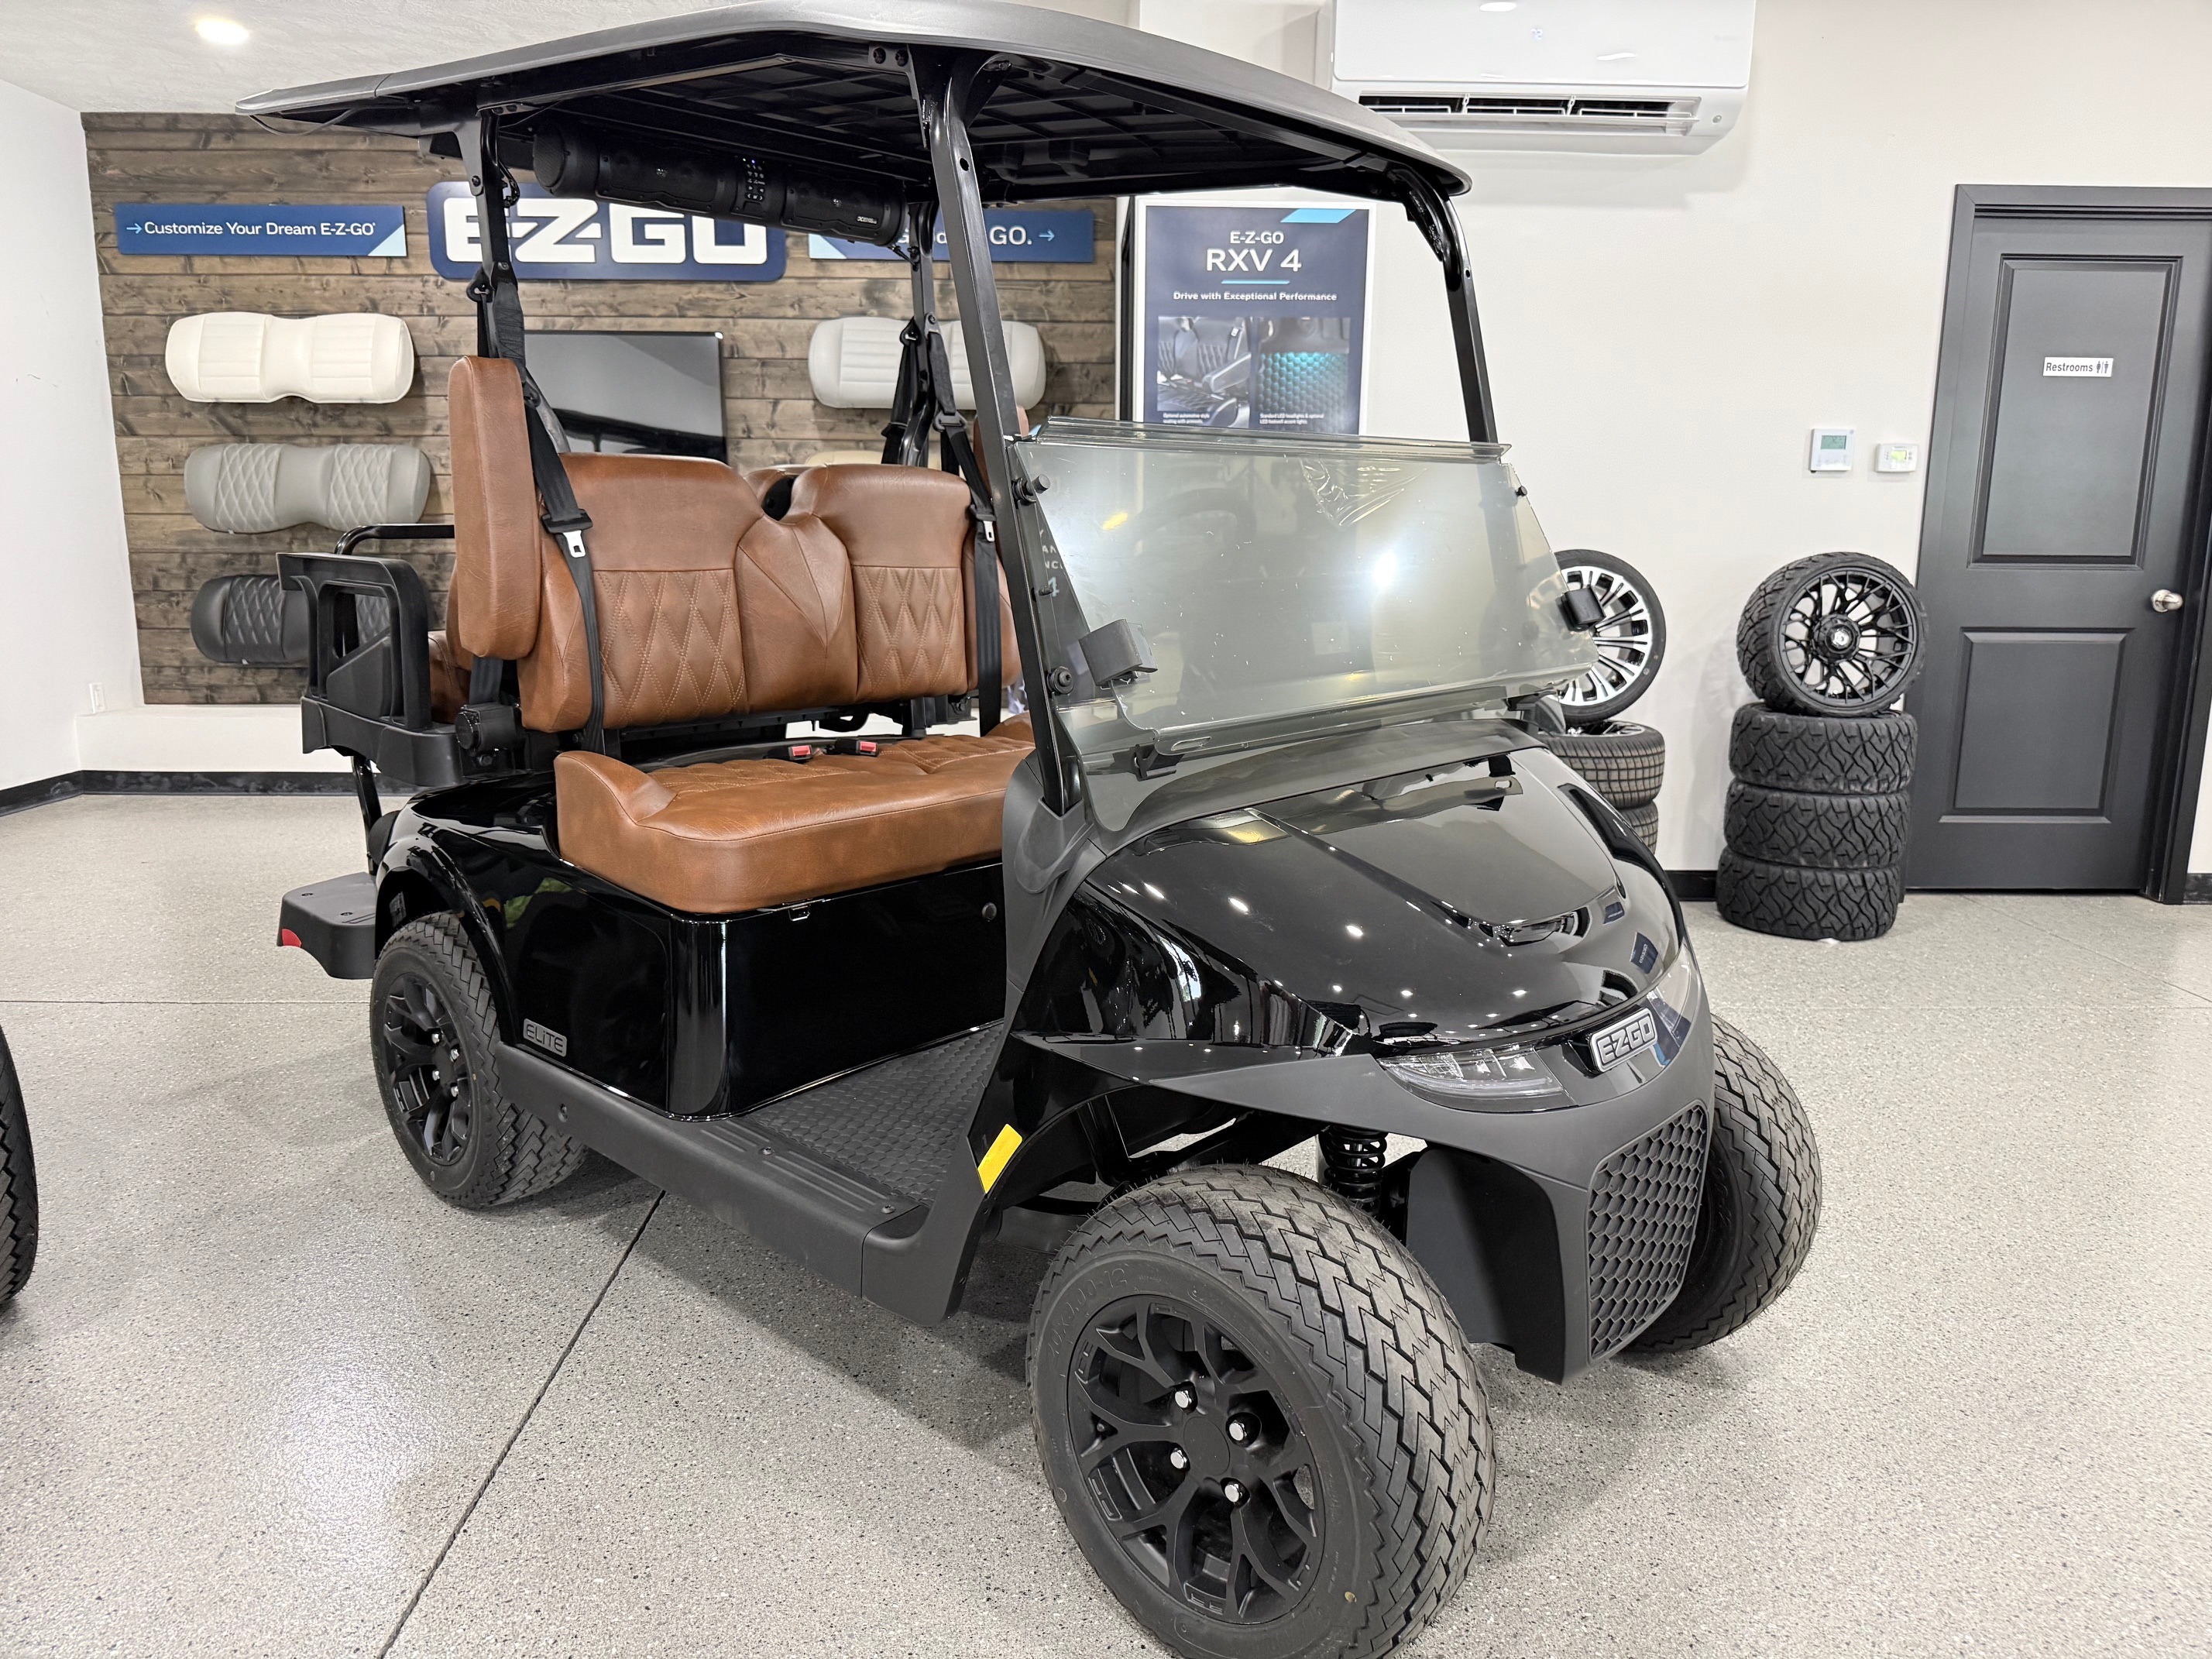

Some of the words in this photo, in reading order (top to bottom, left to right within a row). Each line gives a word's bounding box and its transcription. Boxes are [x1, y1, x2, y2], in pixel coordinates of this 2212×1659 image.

[144, 222, 223, 235] Customize
[225, 222, 260, 235] Your
[266, 222, 316, 235] Dream
[1230, 231, 1284, 244] E-Z-GO
[1206, 249, 1273, 271] RXV
[1280, 249, 1302, 272] 4
[1173, 291, 1198, 301] Drive
[1200, 291, 1221, 301] with
[1223, 291, 1277, 301] Exceptional
[1279, 292, 1338, 301] Performance
[2045, 362, 2094, 372] Restrooms
